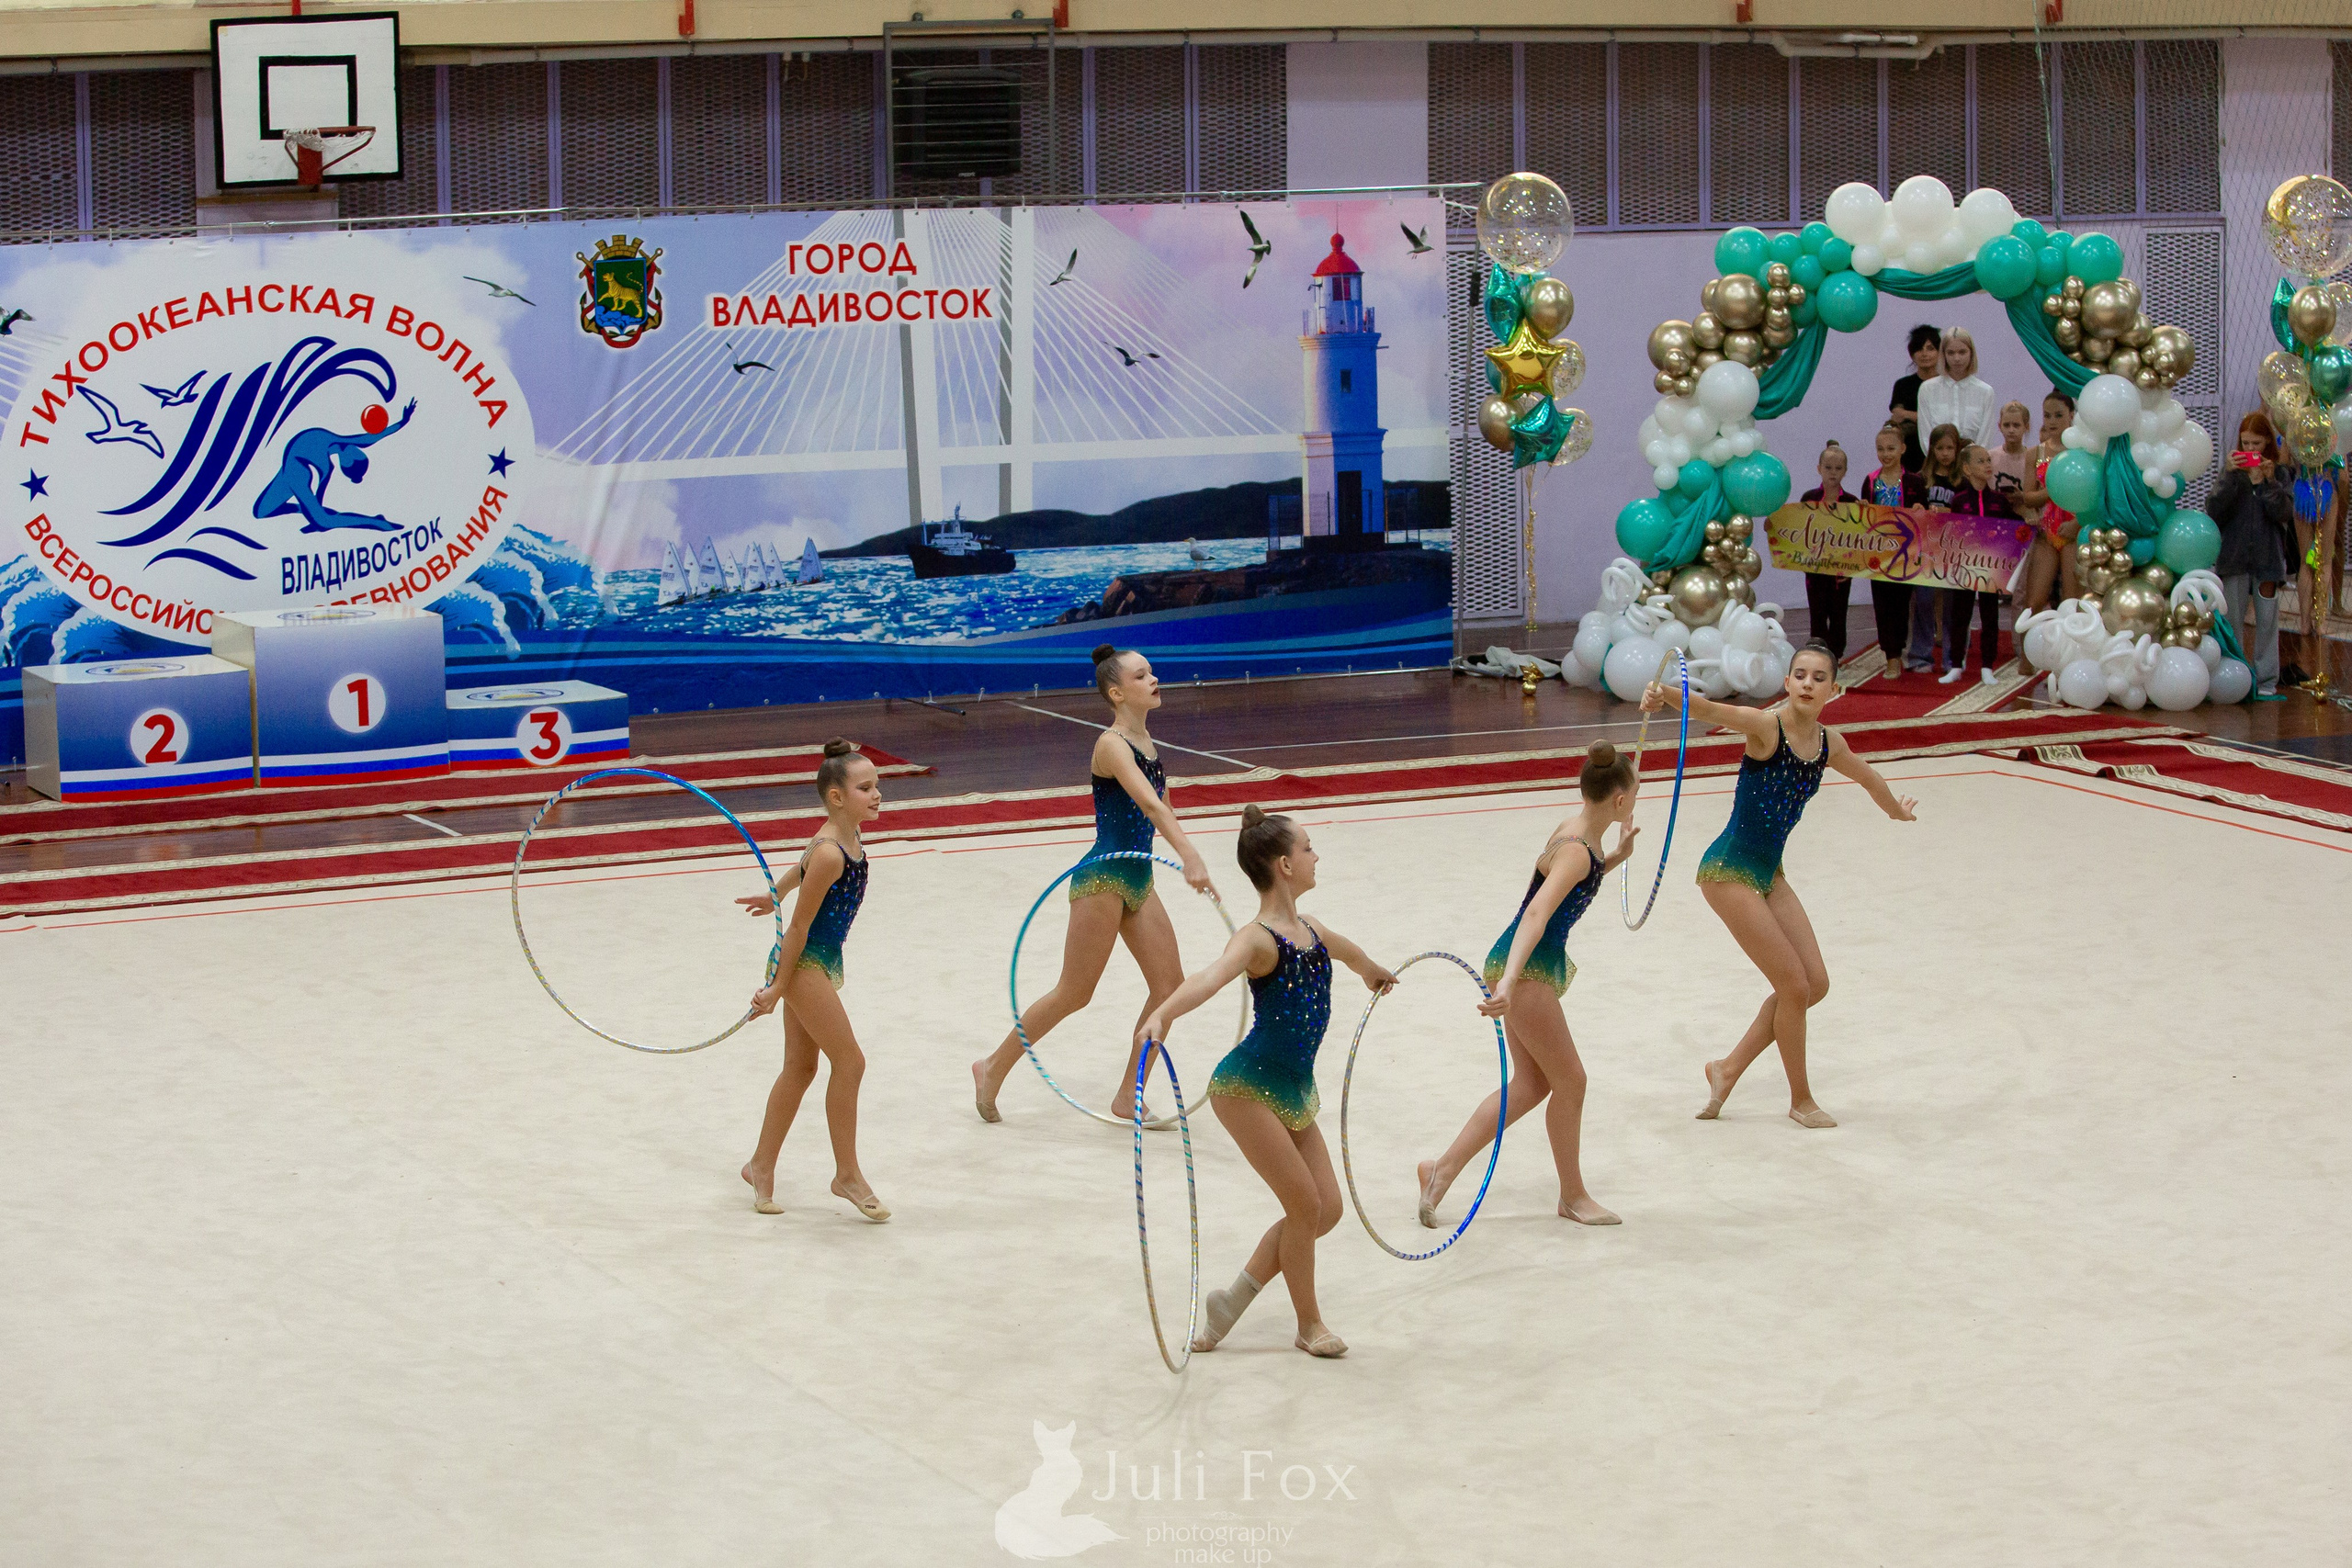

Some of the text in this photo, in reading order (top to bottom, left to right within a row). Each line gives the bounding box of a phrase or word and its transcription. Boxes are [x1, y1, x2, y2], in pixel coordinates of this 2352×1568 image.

[789, 243, 917, 276] ГОРОД
[713, 288, 992, 328] ВЛАДИВОСТОК
[20, 284, 508, 447] ТИХООКЕАНСКАЯ ВОЛНА
[24, 513, 225, 635] ВСЕРОССИЙС
[281, 517, 443, 595] ВЛАДИВОСТОК
[347, 679, 369, 728] 1
[144, 714, 177, 764] 2
[529, 711, 561, 761] 3
